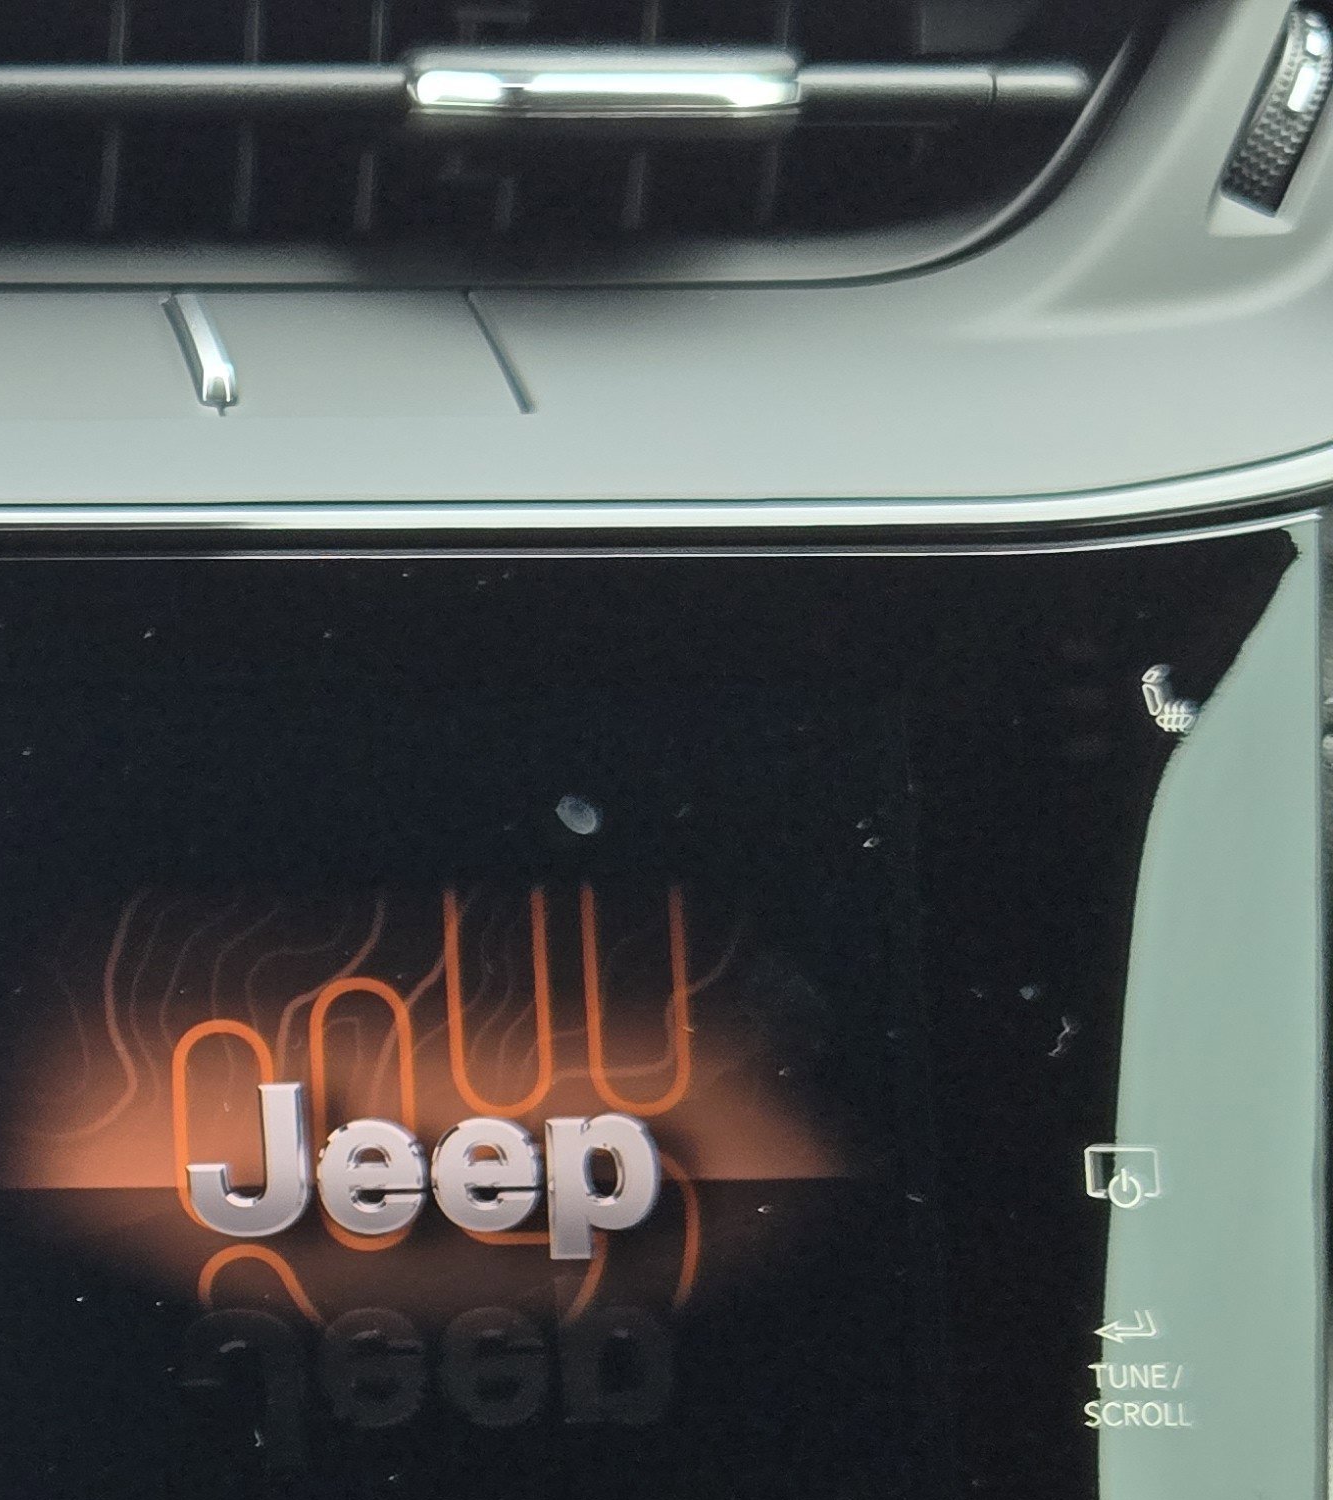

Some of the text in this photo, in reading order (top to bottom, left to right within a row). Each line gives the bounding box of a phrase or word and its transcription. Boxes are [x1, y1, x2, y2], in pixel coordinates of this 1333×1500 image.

[186, 1082, 661, 1260] Jeep
[1088, 1363, 1182, 1390] TUNE/
[1083, 1401, 1191, 1428] SCROLL
